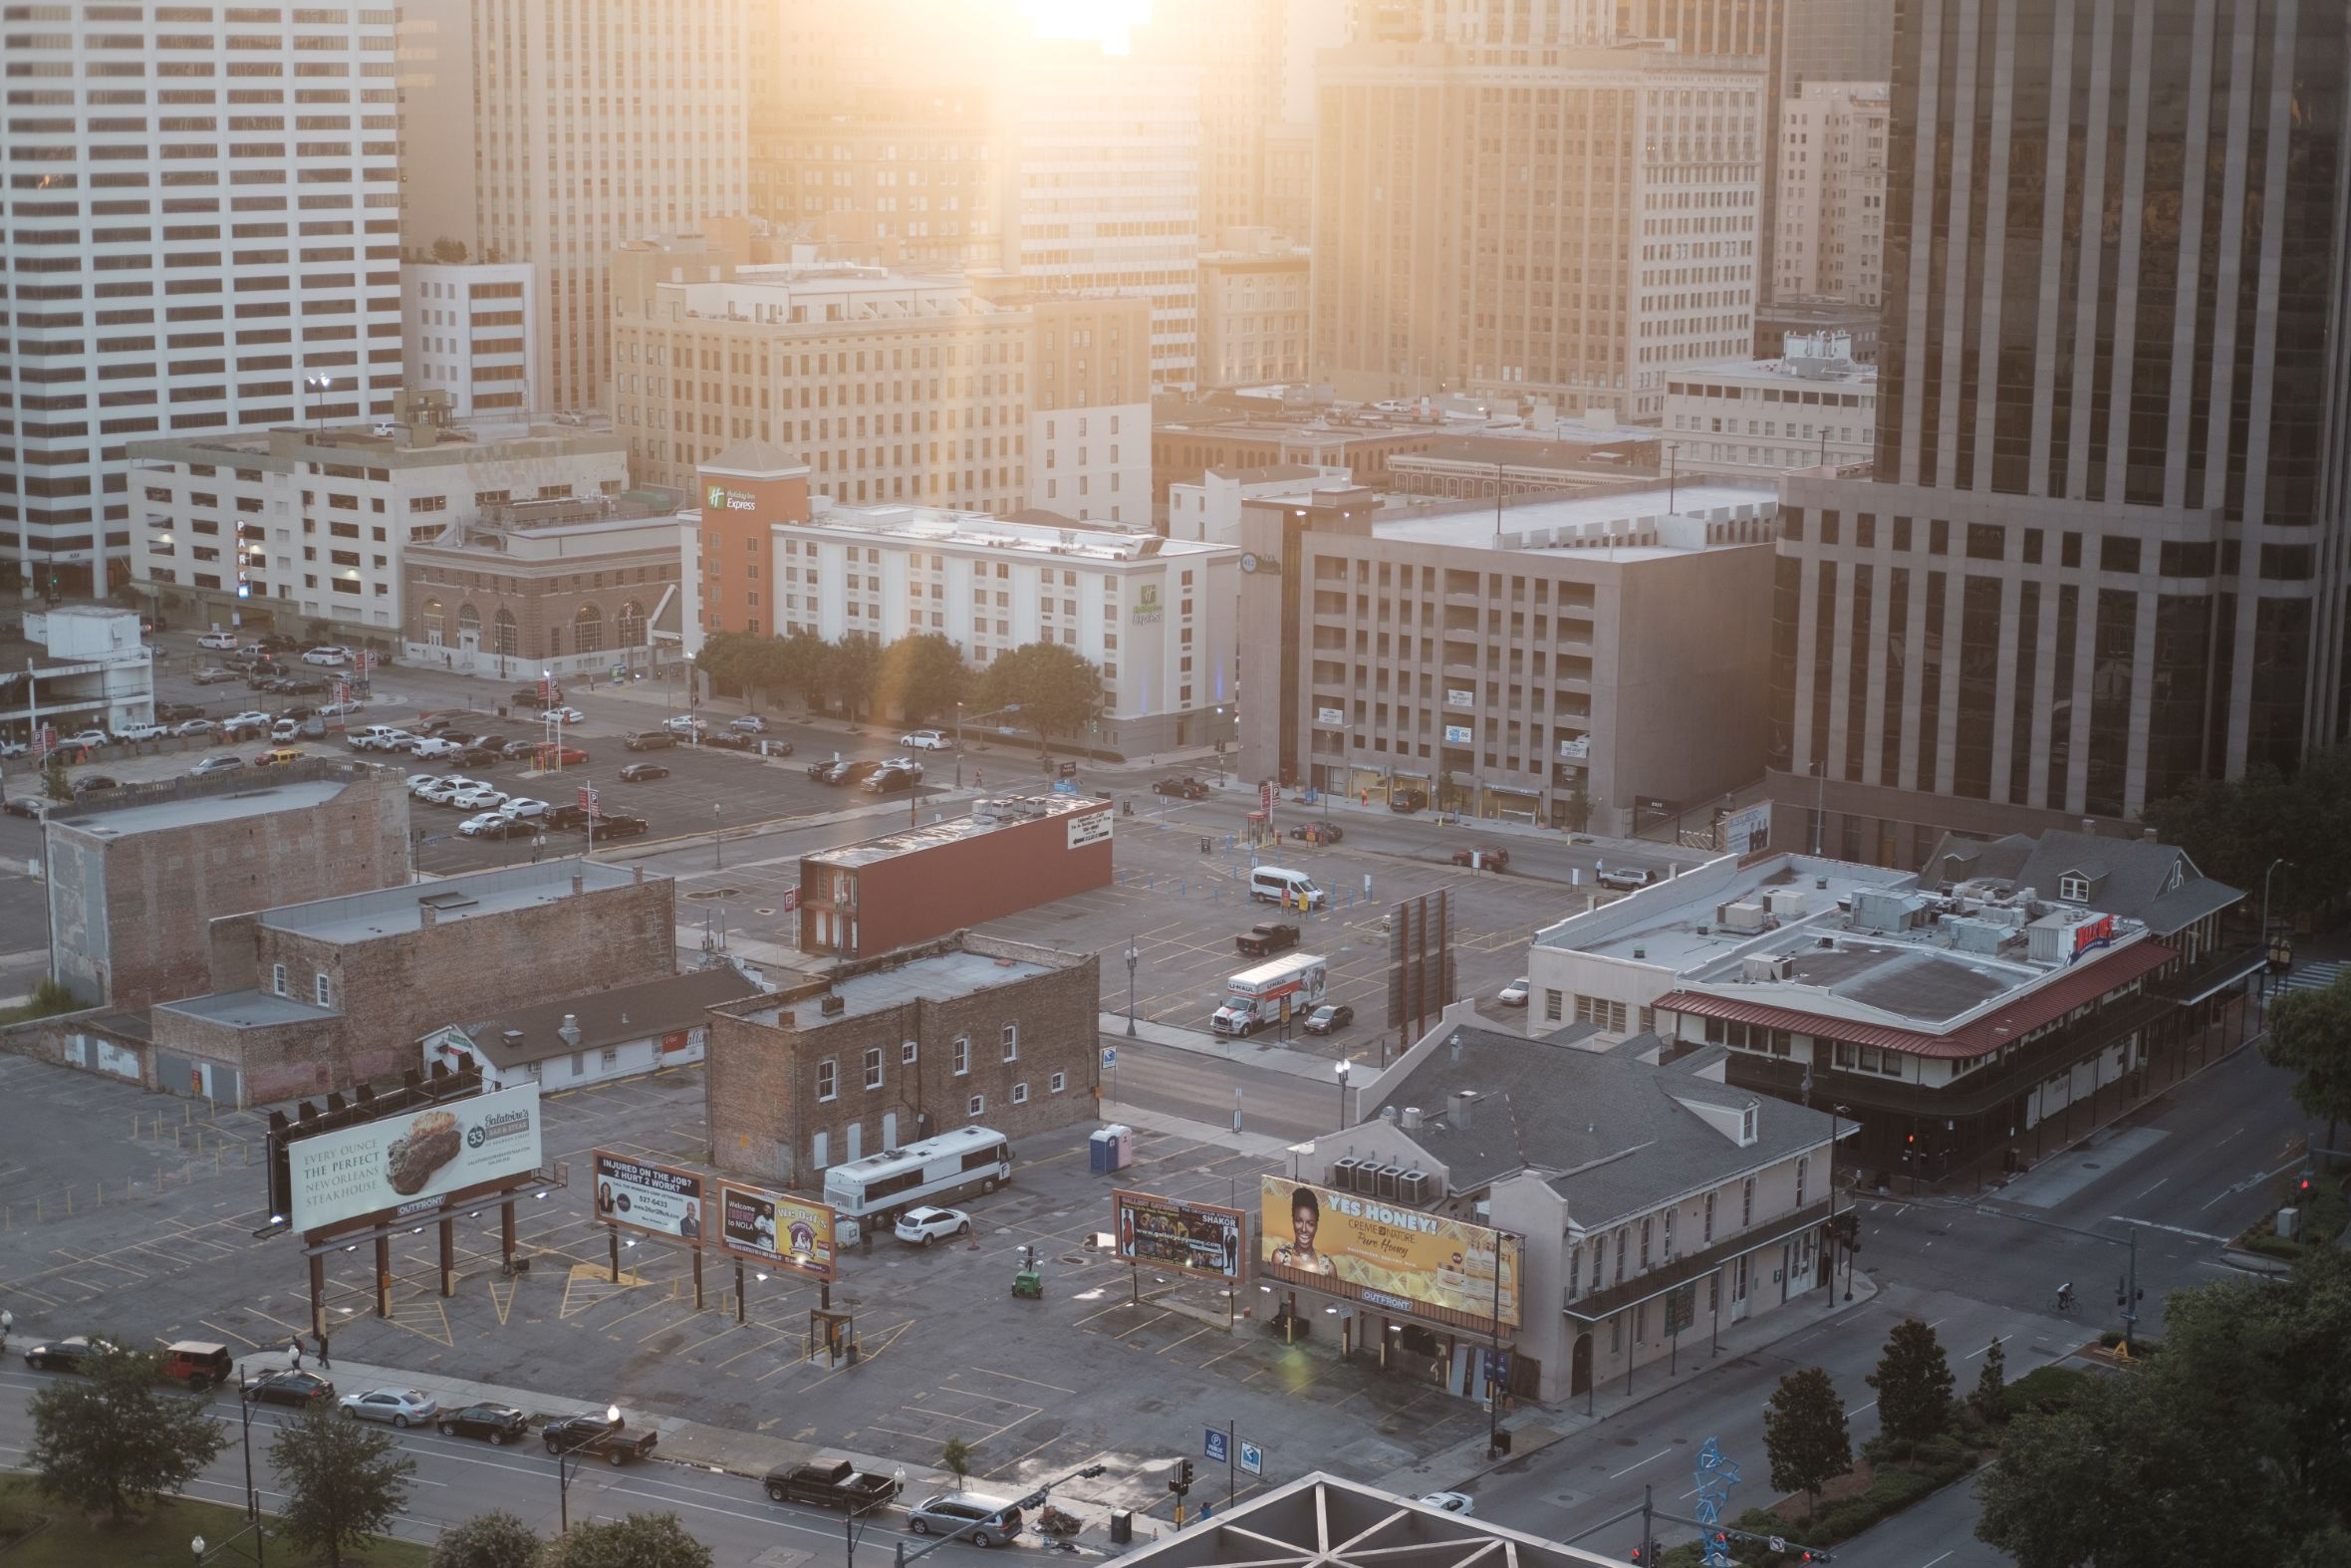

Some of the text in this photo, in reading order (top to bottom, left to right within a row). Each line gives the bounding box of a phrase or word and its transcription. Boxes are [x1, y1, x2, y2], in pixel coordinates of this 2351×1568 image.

[727, 490, 746, 500] Holiday
[727, 498, 755, 510] Express
[238, 521, 246, 581] PARK
[1133, 614, 1164, 626] Express
[592, 794, 596, 802] P
[1229, 983, 1254, 993] U-HAUL
[1267, 979, 1287, 989] U-HAUL
[508, 1121, 527, 1131] STEAK
[470, 1130, 484, 1145] 33
[304, 1139, 378, 1165] EVERY OUNCE
[304, 1152, 380, 1179] THE PERFECT
[306, 1166, 379, 1193] NEW ORLEANS
[603, 1159, 638, 1175] INJURED
[639, 1168, 651, 1177] ON
[653, 1171, 669, 1182] THE
[671, 1176, 692, 1187] JOB?
[621, 1172, 643, 1183] HURT
[652, 1179, 680, 1193] WORK?
[399, 1195, 443, 1214] OUTFRONT
[639, 1196, 667, 1208] 527-6433
[728, 1200, 756, 1212] Welcome
[728, 1208, 755, 1223] ESSENCE
[778, 1208, 795, 1218] We
[1328, 1195, 1437, 1235] YES HONEY!
[736, 1221, 754, 1231] NOLA
[1202, 1215, 1235, 1227] SHAKOR
[1136, 1228, 1221, 1248] www.gallerycayenne.com
[1348, 1219, 1378, 1234] CREME
[1386, 1229, 1416, 1244] NATURE
[1356, 1232, 1378, 1248] Pure
[1381, 1238, 1409, 1258] Honey
[1364, 1291, 1409, 1310] OUTFRONT
[1206, 1449, 1225, 1461] PARKING
[1208, 1444, 1223, 1454] PUBLIC
